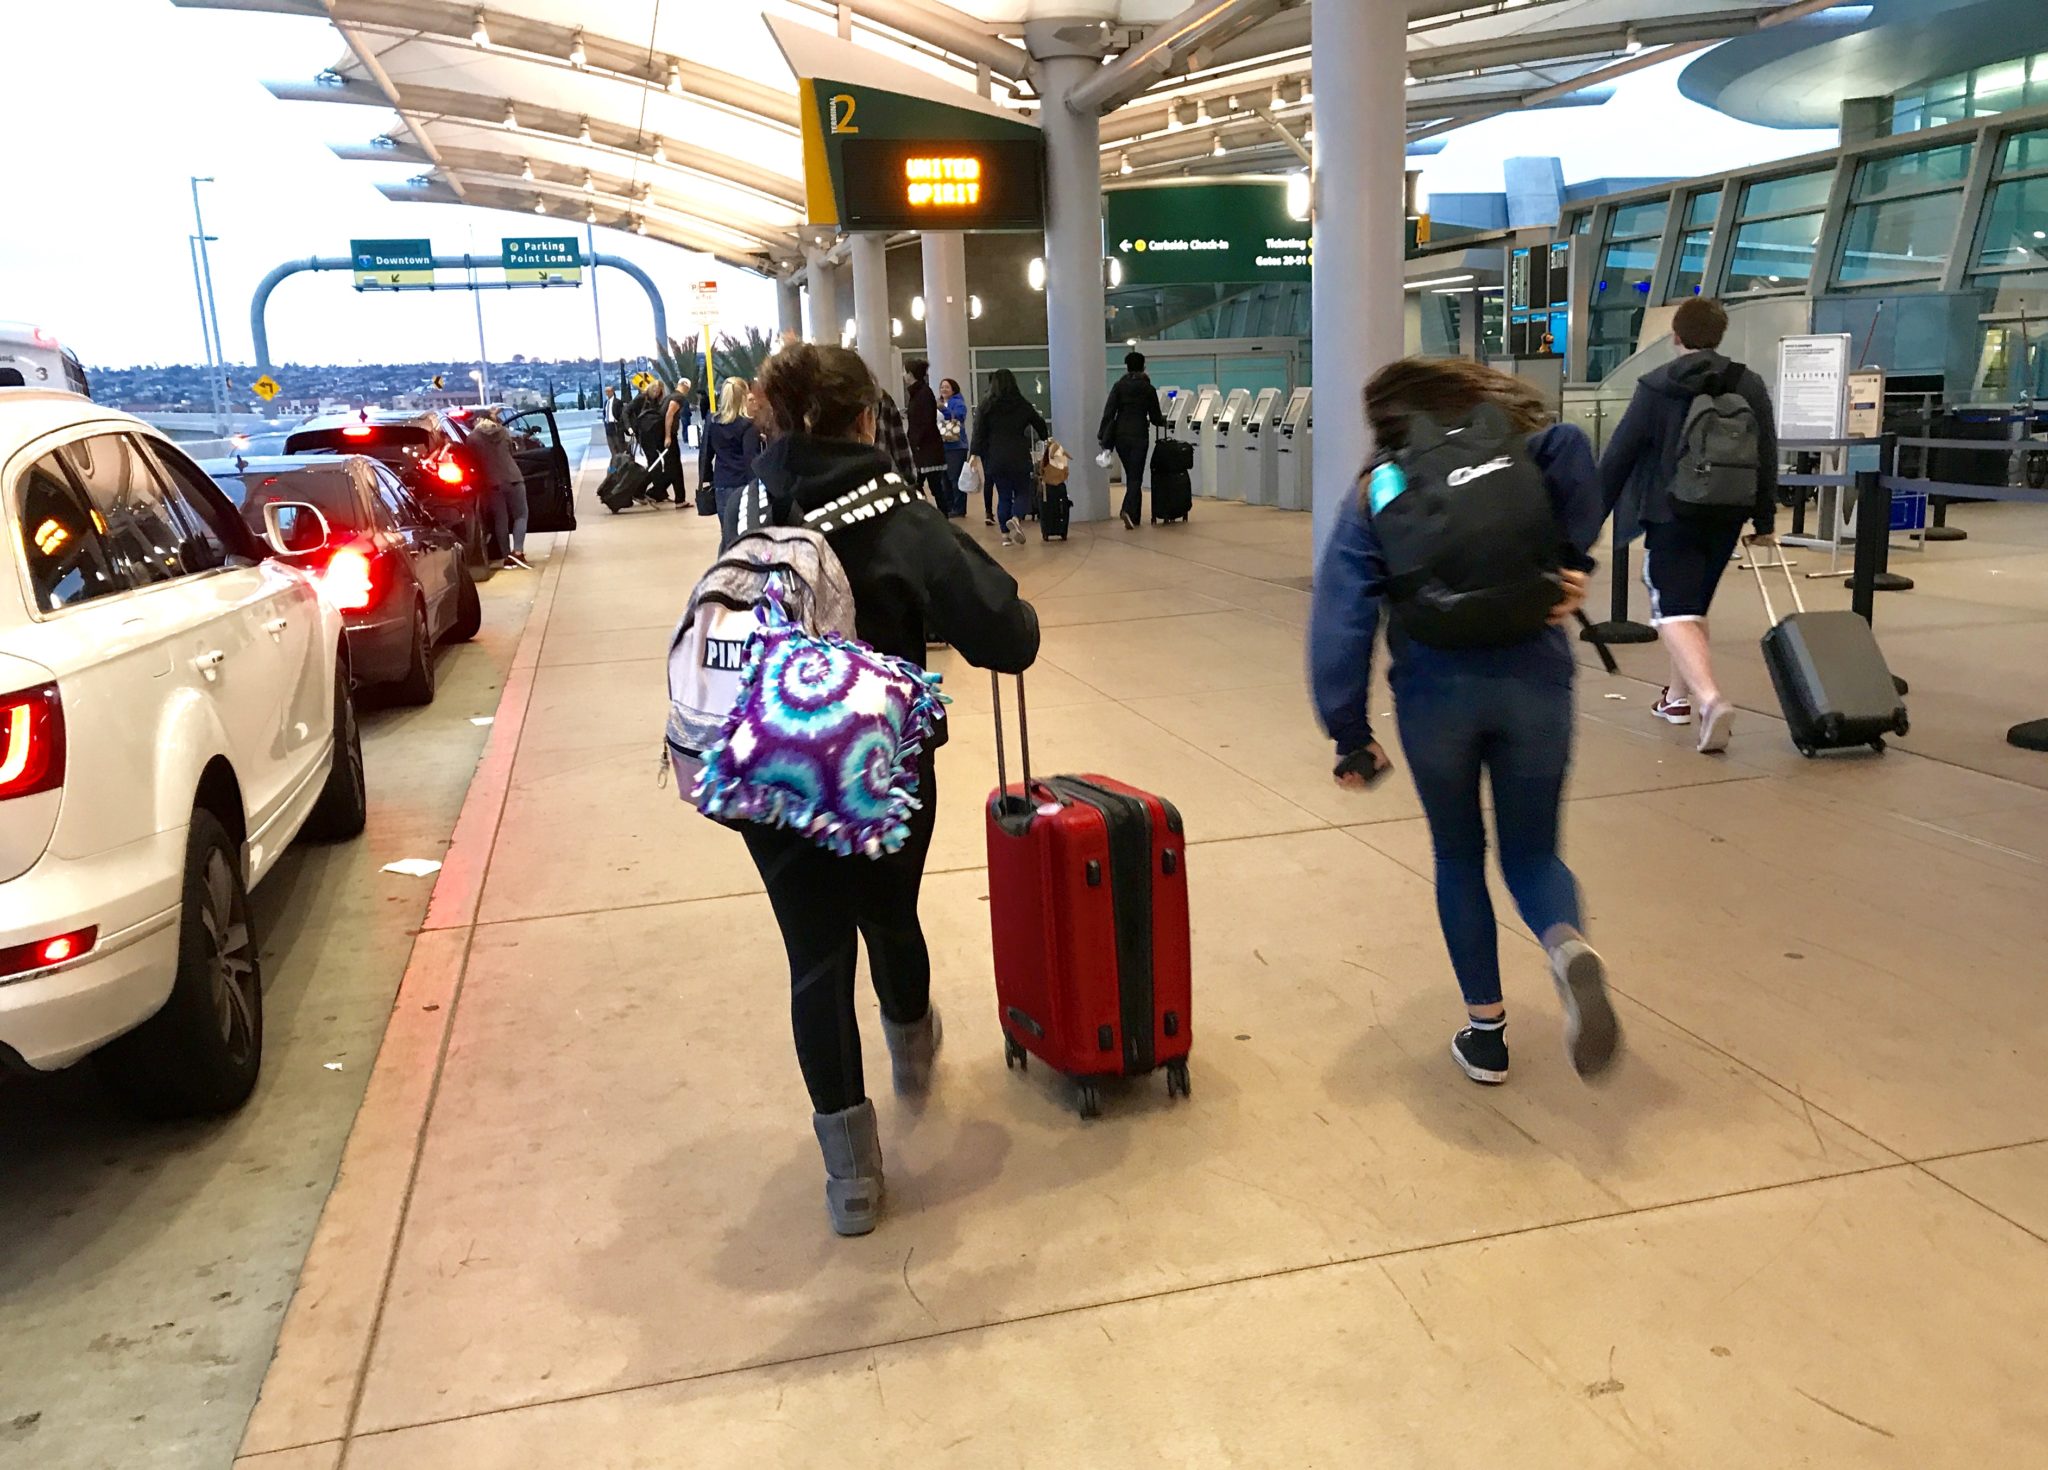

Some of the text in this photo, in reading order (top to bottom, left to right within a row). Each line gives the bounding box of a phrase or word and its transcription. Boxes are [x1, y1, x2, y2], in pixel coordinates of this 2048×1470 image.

[829, 94, 860, 135] TERMINAL 2
[905, 157, 980, 180] UNITED
[907, 182, 980, 206] SPIRIT
[524, 242, 565, 253] Parking
[1148, 239, 1189, 251] Curbside
[1265, 237, 1307, 251] Ticketing
[375, 255, 431, 265] Downtown
[510, 253, 573, 264] Point Loma
[1255, 255, 1282, 266] Gates
[36, 367, 49, 381] 3
[706, 640, 745, 669] PIN
